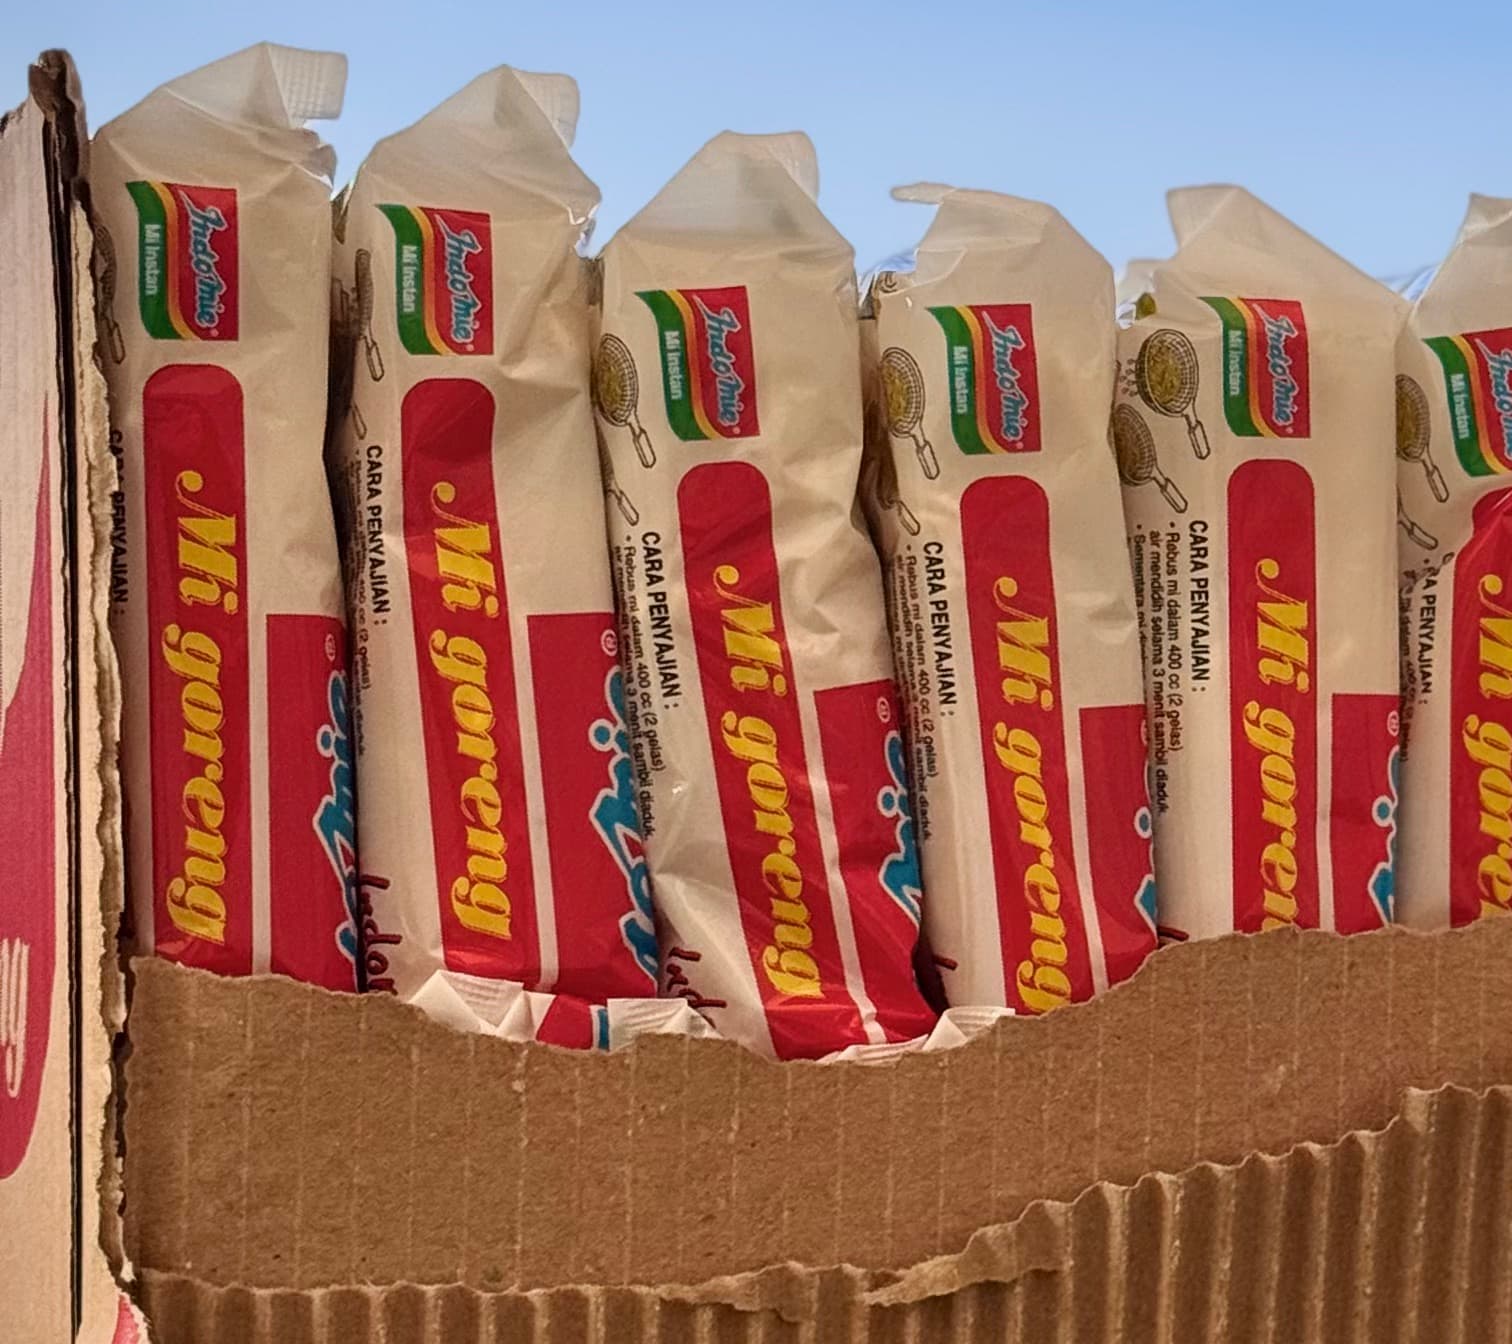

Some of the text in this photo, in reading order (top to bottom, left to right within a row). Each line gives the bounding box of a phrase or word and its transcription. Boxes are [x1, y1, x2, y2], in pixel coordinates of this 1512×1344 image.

[144, 224, 161, 296] Mi Instan
[402, 245, 417, 312] Mi Instan
[664, 330, 683, 400] Mi Instan
[953, 346, 968, 414] Mi Instan
[1229, 330, 1242, 396] Mi Instan
[1451, 374, 1470, 439] Mi Instan
[367, 446, 382, 500] CARA
[367, 506, 391, 613] PENYAJIAN
[642, 532, 664, 586] CARA
[1150, 531, 1162, 547] air
[1189, 521, 1208, 573] CARA
[924, 542, 947, 595] CARA
[1151, 551, 1164, 612] mendidih
[1167, 580, 1181, 595] mi
[648, 592, 682, 698] PENYAJIAN
[1152, 616, 1165, 664] selama
[1167, 599, 1181, 641] dalam
[1190, 578, 1210, 680] PENYAJIAN
[1255, 557, 1311, 694] Mi
[1418, 594, 1436, 693] PENYAJIAN
[637, 663, 651, 688] 400
[930, 600, 957, 704] PENYAJIAN
[1153, 669, 1165, 677] 3
[1168, 645, 1182, 669] 400
[163, 470, 239, 946] Mi goreng
[640, 692, 652, 709] cc
[919, 669, 931, 695] 400
[920, 698, 930, 714] cc
[1153, 682, 1165, 718] menit
[1167, 693, 1183, 706] (2
[1169, 674, 1180, 689] cc
[428, 481, 513, 942] Mi goreng
[642, 712, 658, 726] (2
[921, 719, 934, 732] (2
[1167, 710, 1183, 752] gelas)
[1154, 722, 1167, 765] sambil
[713, 564, 824, 999] Mi goreng
[993, 576, 1073, 1016] Mi goreng
